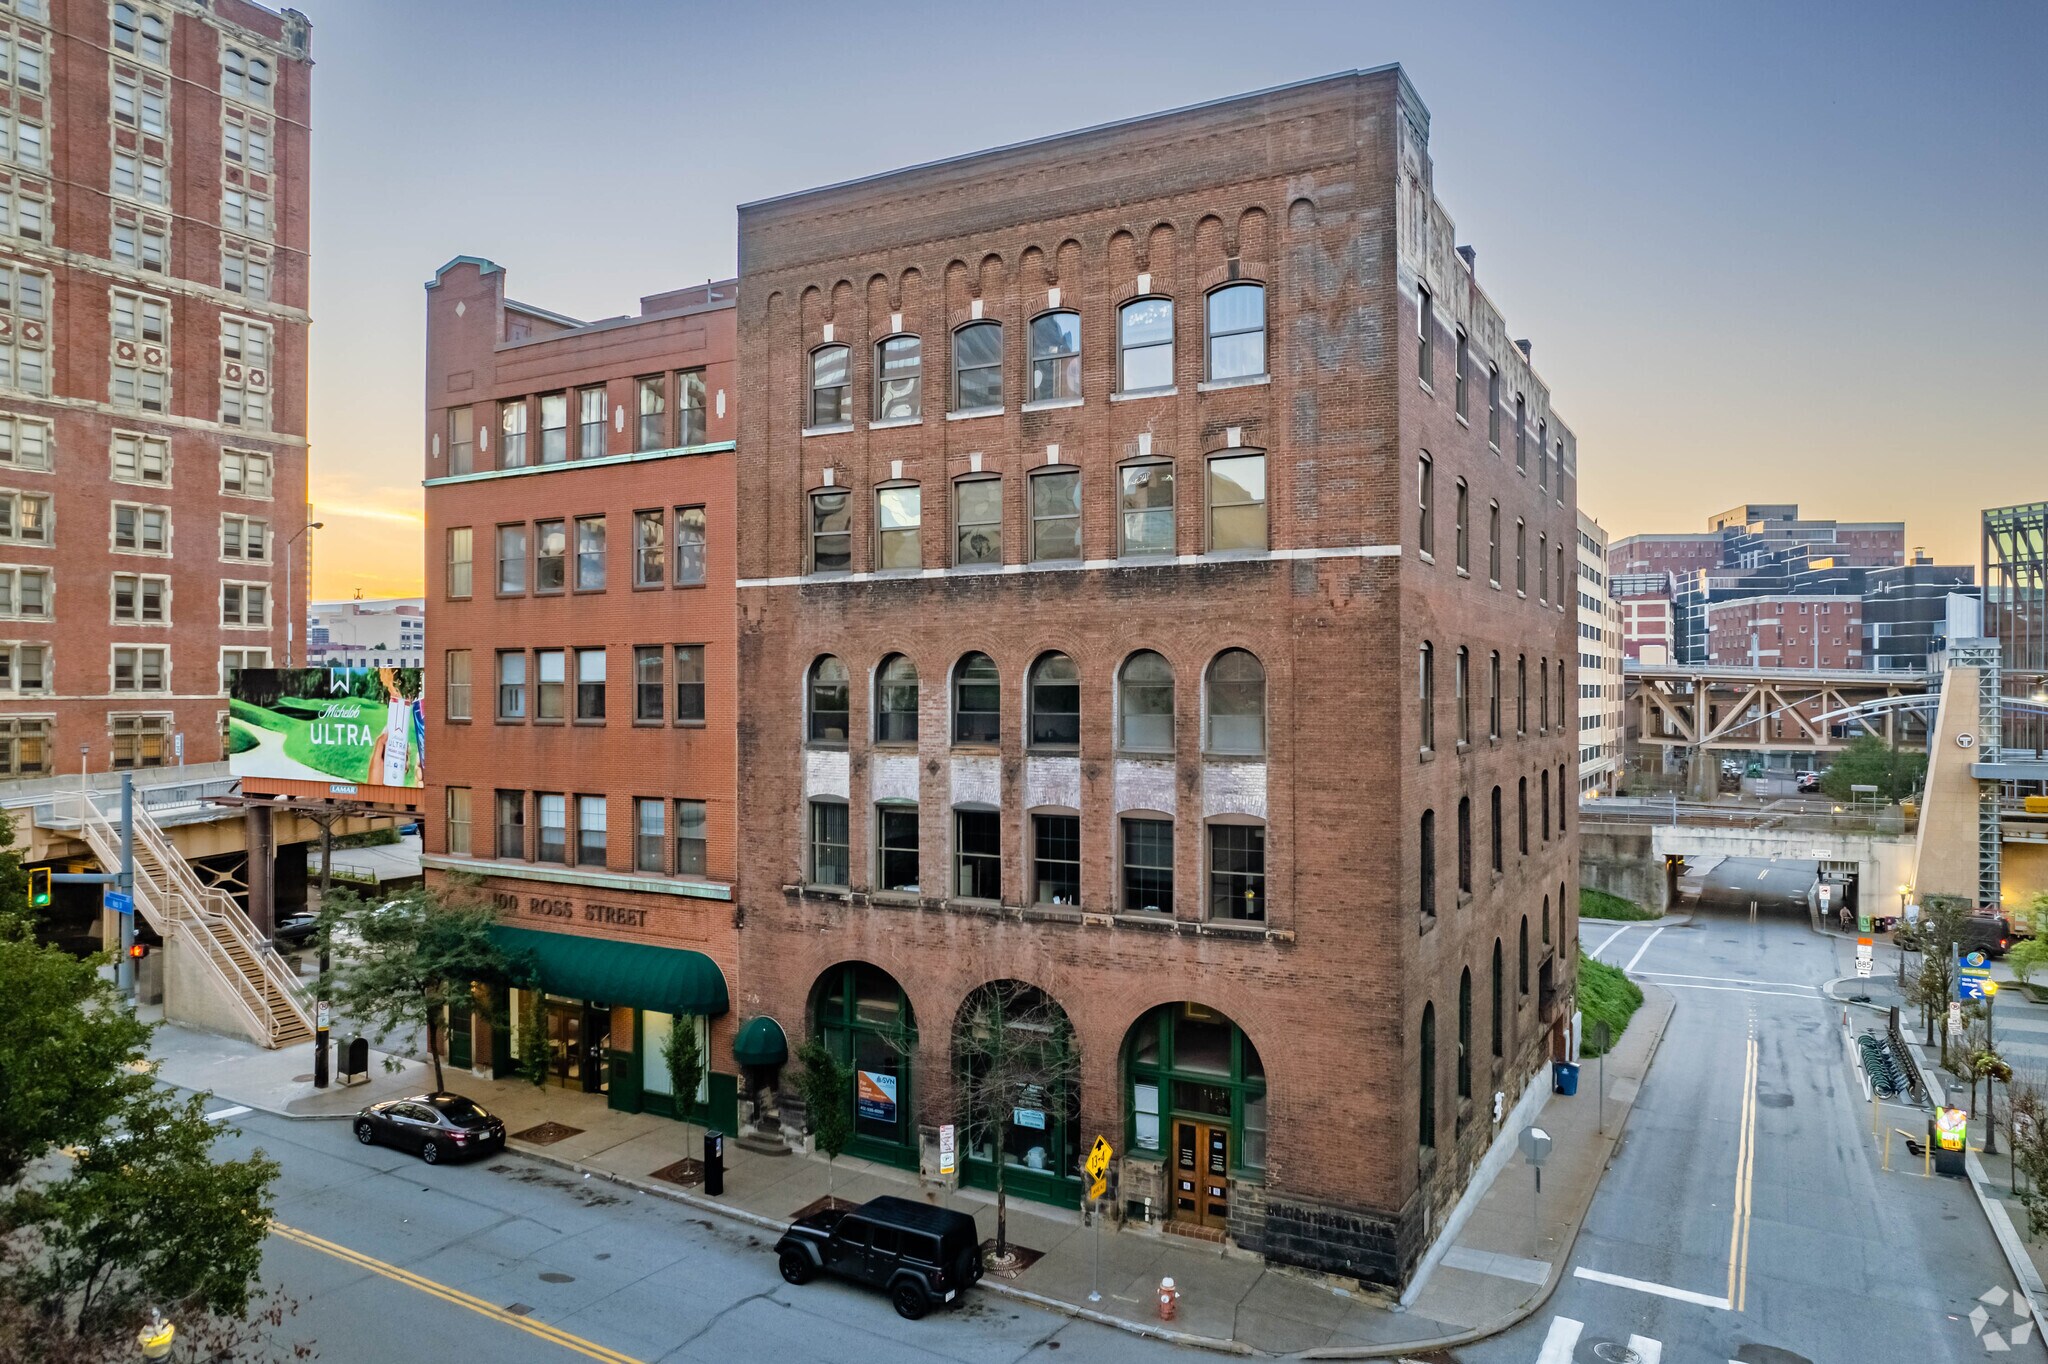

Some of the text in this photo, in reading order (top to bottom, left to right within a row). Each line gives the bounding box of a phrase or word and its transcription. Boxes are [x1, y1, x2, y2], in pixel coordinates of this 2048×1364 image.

[318, 703, 361, 719] Michelob
[310, 723, 373, 747] ULTRA
[331, 785, 356, 793] LAMAR
[530, 898, 574, 919] ROSS
[584, 904, 648, 928] STREET
[1857, 960, 1872, 969] 885
[882, 1076, 895, 1085] SVN
